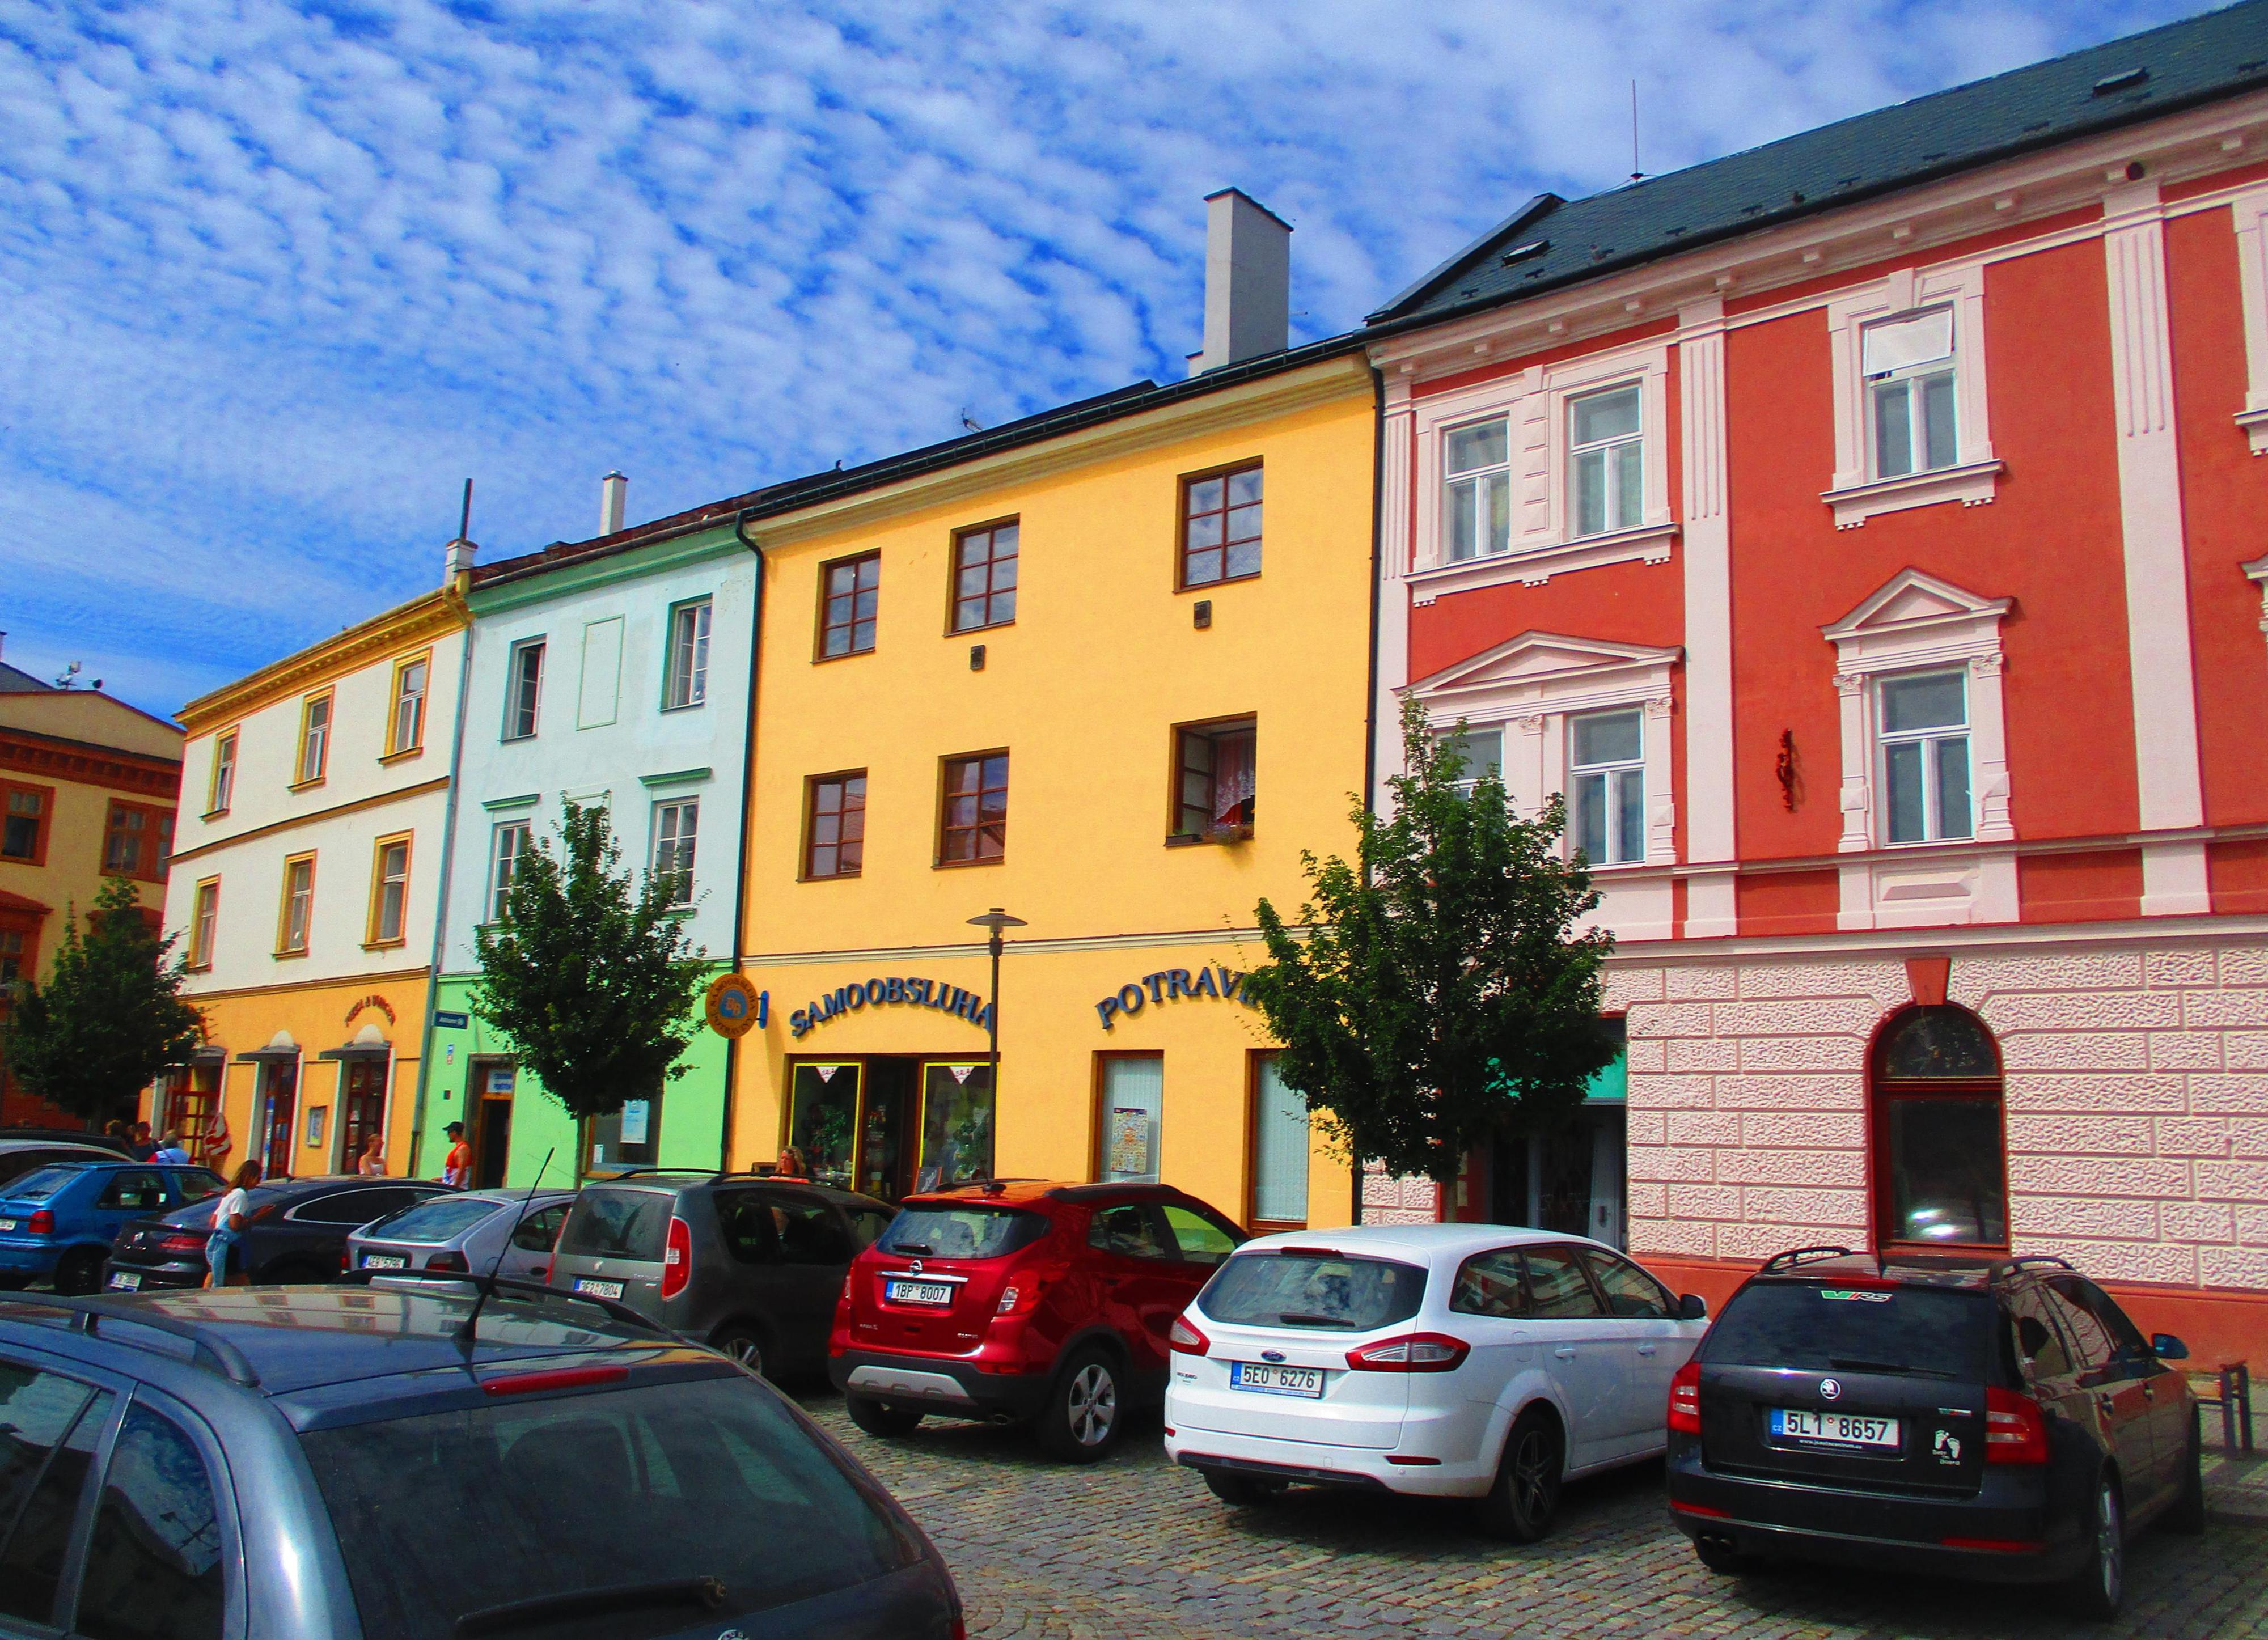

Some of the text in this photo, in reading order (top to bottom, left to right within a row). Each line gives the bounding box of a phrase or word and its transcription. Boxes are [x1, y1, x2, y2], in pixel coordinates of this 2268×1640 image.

[790, 977, 992, 1037] SAMOOBSLUHA
[896, 1284, 946, 1301] 1BP 8007
[1280, 1369, 1315, 1389] 6276
[1787, 1413, 1888, 1442] 5L1 8657
